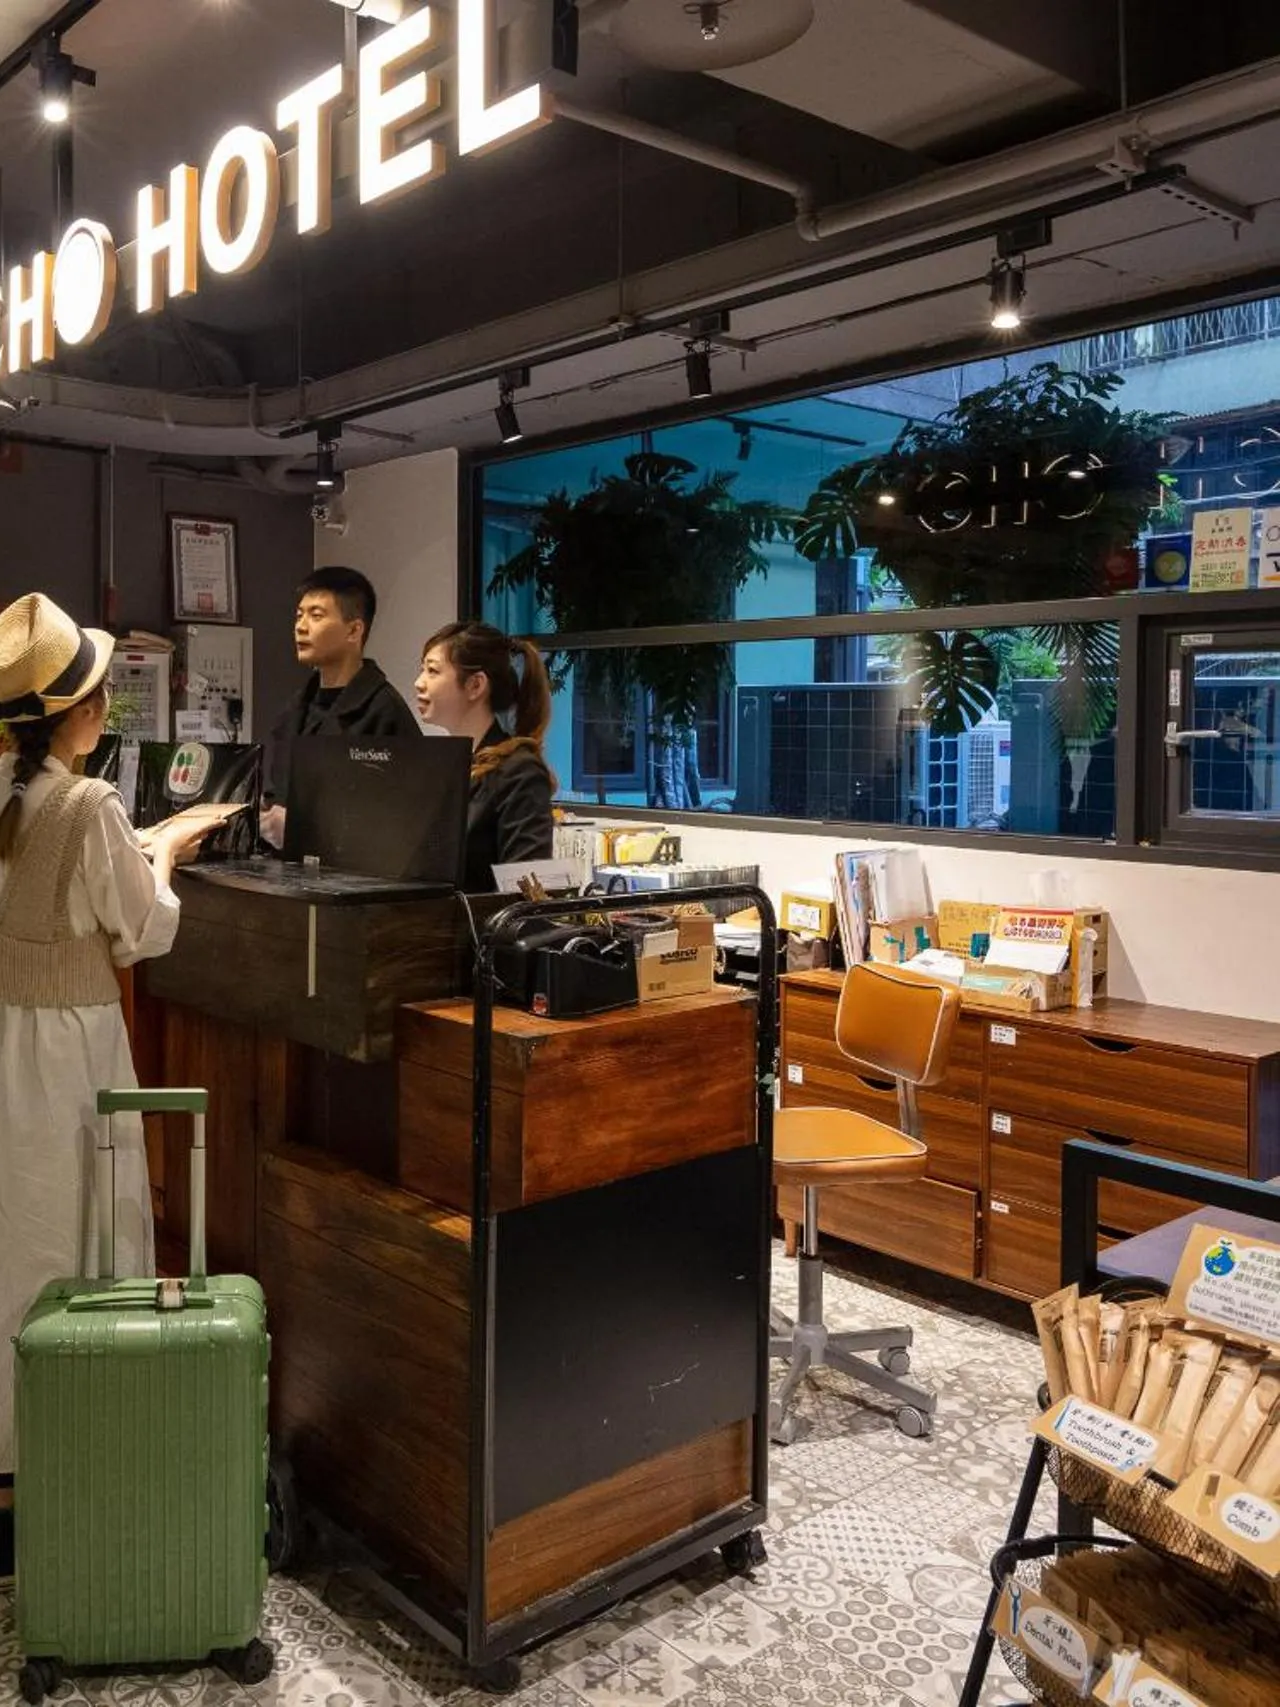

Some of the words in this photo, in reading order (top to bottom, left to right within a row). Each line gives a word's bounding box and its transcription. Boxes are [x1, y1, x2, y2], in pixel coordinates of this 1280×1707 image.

[136, 0, 553, 314] HOTEL
[1065, 1432, 1119, 1464] Toothpaste
[1068, 1419, 1123, 1451] Toothbrush
[1226, 1513, 1260, 1537] Comb
[1024, 1620, 1054, 1650] Dental
[1057, 1644, 1082, 1671] Floss
